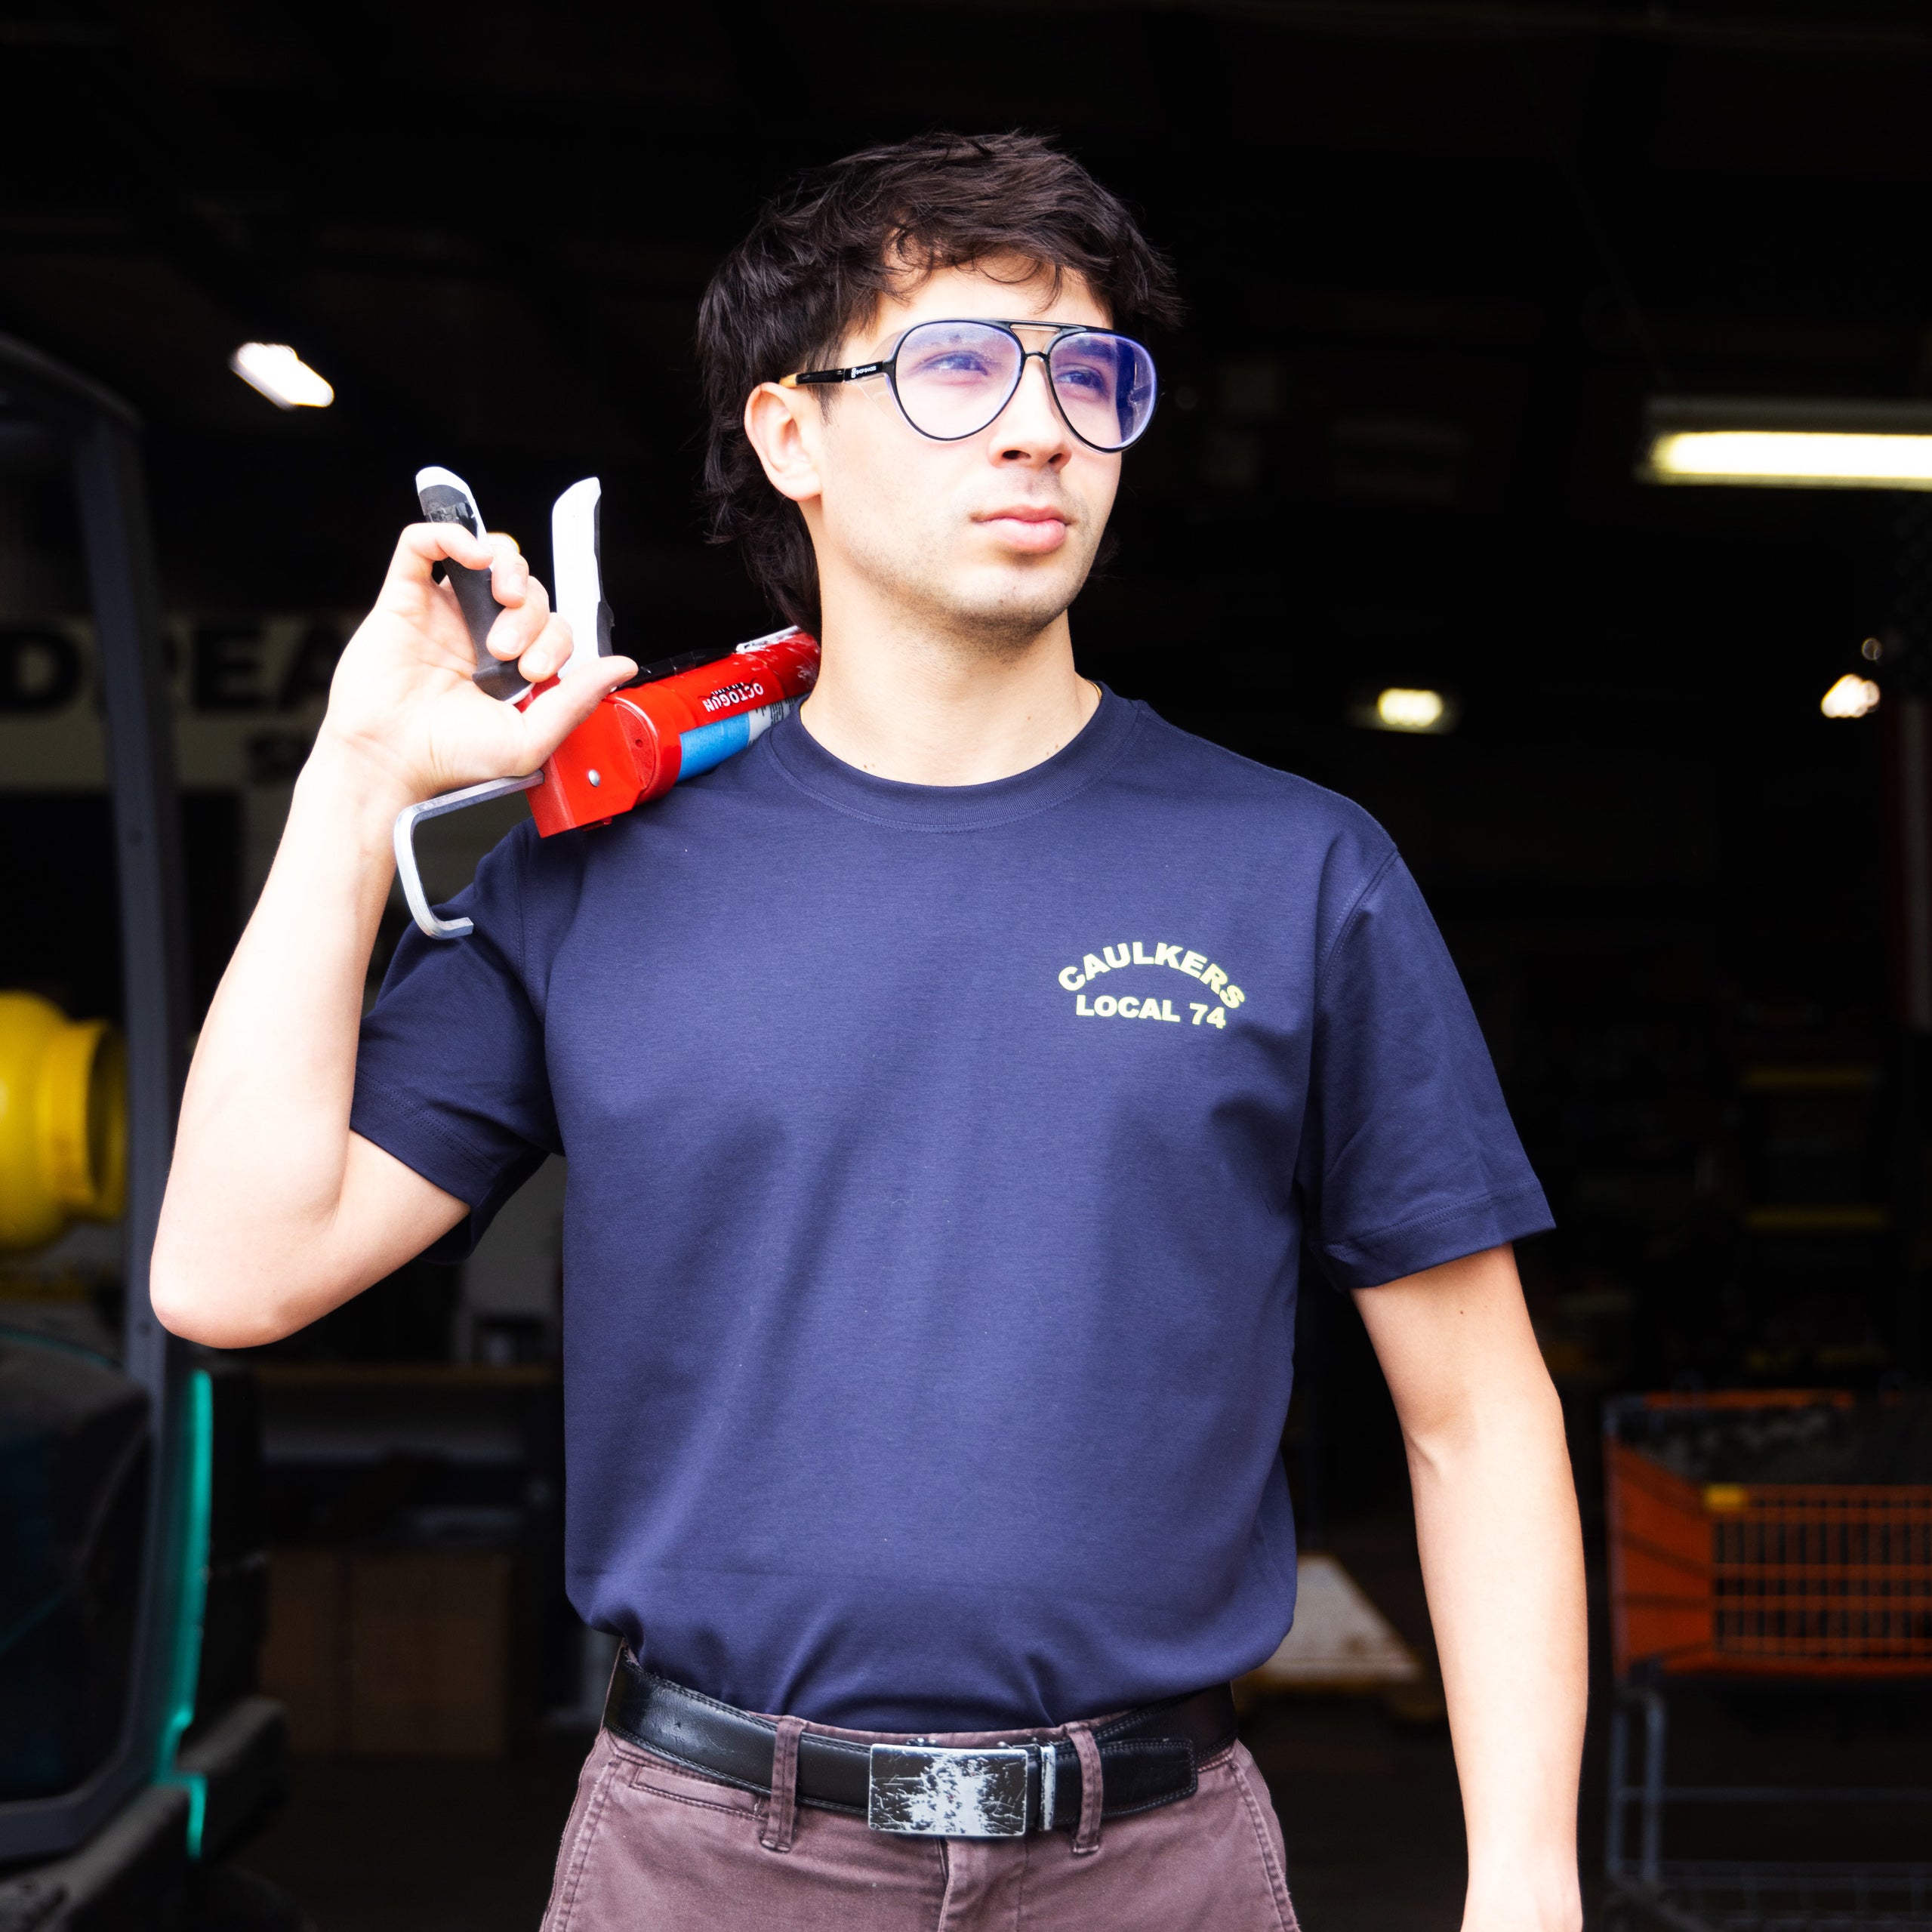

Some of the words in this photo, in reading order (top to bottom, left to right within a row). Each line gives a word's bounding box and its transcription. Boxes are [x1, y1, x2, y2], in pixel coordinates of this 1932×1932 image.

[702, 683, 764, 712] OCTOGUN
[1058, 941, 1245, 1009] CAULKERS
[1076, 994, 1180, 1022] LOCAL
[1189, 1003, 1226, 1029] 74
